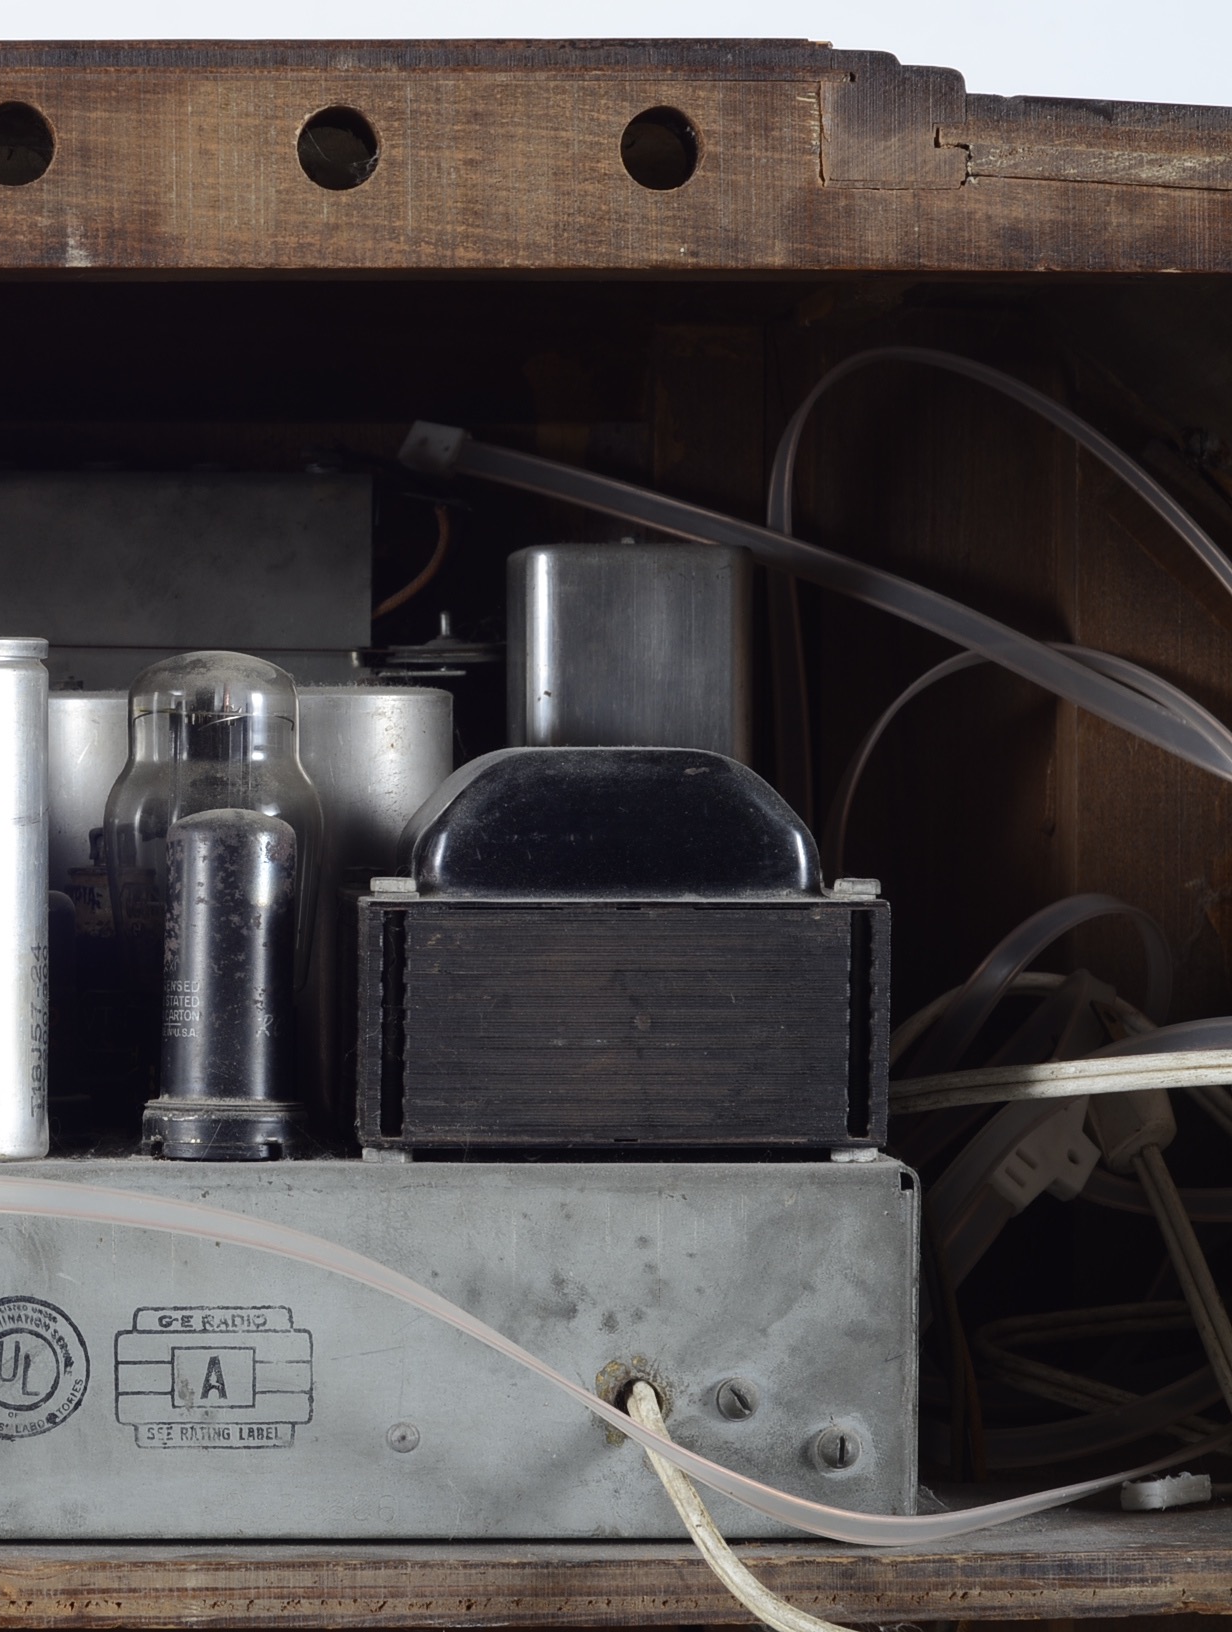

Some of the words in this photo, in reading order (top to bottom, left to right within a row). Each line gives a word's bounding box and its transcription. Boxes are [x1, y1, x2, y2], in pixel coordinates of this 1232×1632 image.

[201, 1314, 267, 1330] RADIO
[200, 1355, 228, 1400] A
[15, 1378, 84, 1433] LABOTORIES
[180, 1426, 231, 1441] RATING
[238, 1427, 282, 1440] LABEL
